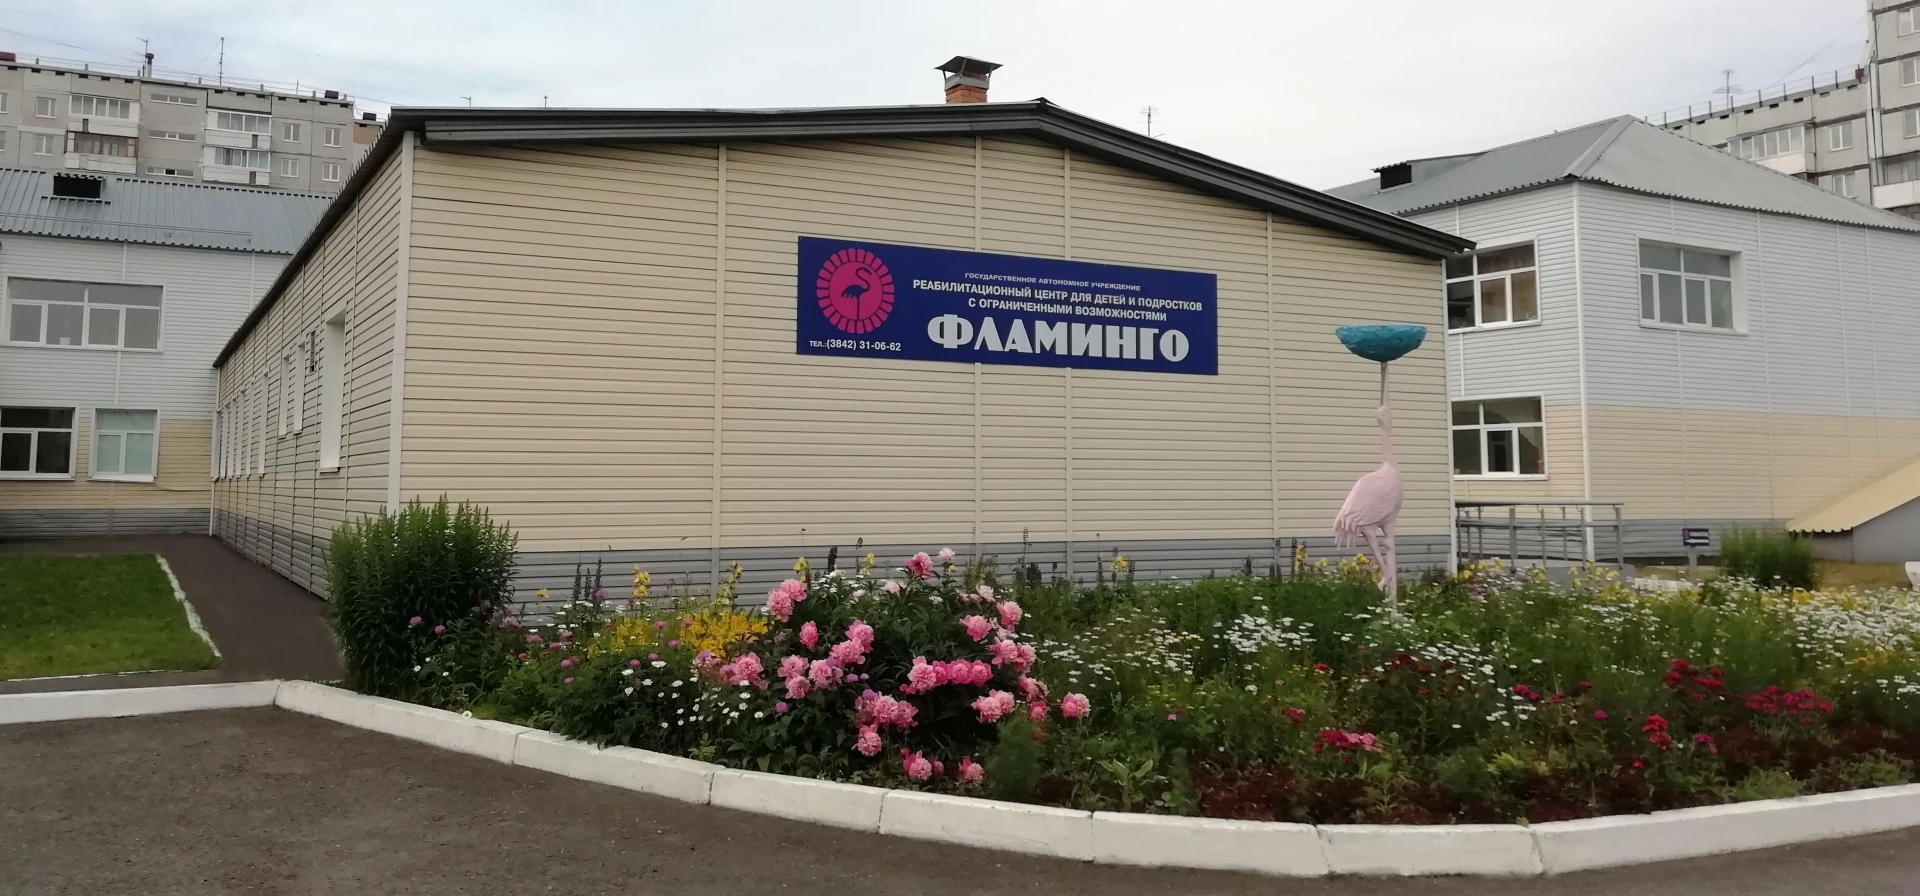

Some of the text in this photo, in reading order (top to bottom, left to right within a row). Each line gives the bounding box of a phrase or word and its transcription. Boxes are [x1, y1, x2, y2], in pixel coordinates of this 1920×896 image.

[965, 273, 1141, 291] ГОСУДАРСТВЕННОЕ АВТОНОМНОЕ УЧРЕЖДЕНИЕ
[913, 279, 1203, 311] РЕАБИЛИТАЦИОННЫЙ ЦЕНТР ДЛЯ ДЕТЕЙ И ПОДРОСТКОВ
[968, 298, 1167, 321] С ОГРАНИЧЕННЫМИ ВОЗМОЖНОСТЯМИ
[859, 340, 902, 351] 31-06-62
[927, 313, 1190, 362] ФЛАМИНГО
